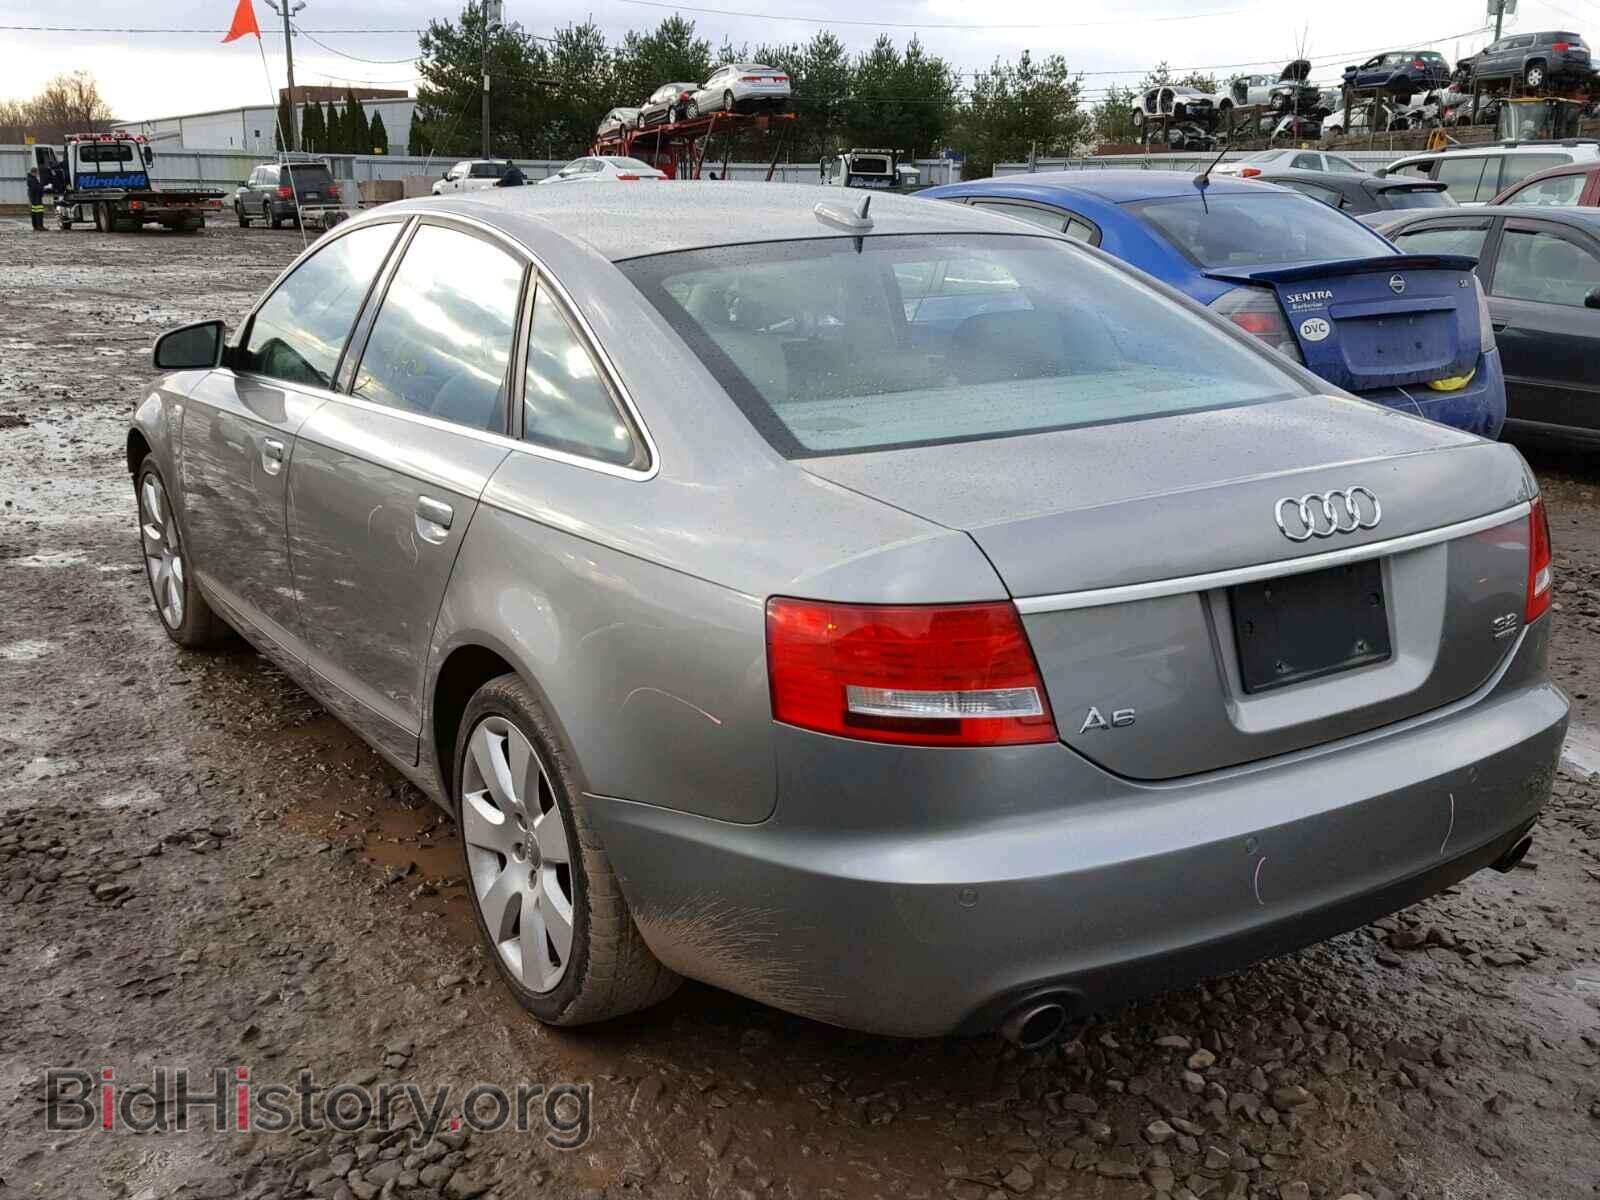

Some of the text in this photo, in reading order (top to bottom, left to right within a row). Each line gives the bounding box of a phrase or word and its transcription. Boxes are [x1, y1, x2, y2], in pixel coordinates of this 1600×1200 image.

[1286, 290, 1333, 303] SENTRA
[1304, 322, 1326, 335] DVC
[1079, 706, 1136, 734] A6
